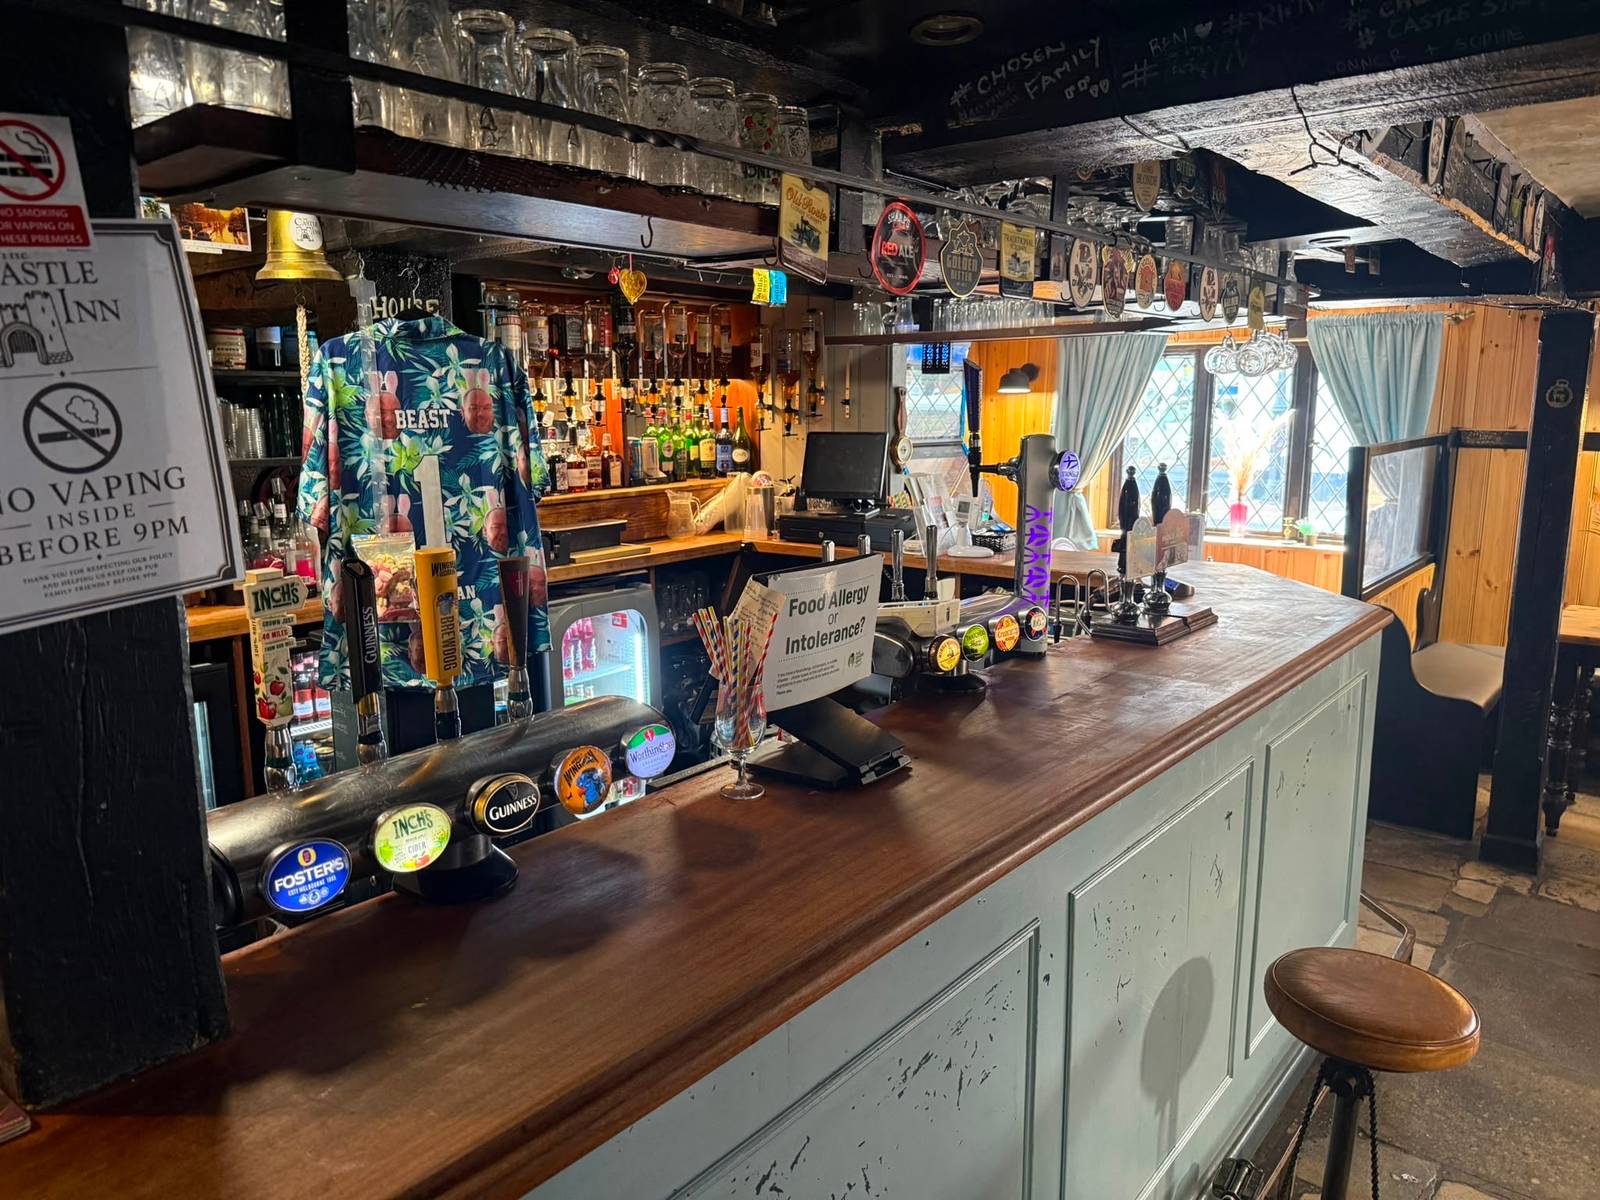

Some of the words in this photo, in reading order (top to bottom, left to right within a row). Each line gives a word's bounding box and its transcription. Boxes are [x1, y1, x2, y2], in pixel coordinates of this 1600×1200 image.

[1024, 36, 1102, 101] FAMILY
[14, 221, 56, 231] VAPING
[57, 222, 75, 231] ON
[16, 208, 68, 218] SMOKING
[0, 234, 30, 243] HESE
[31, 234, 83, 244] PREMISES
[898, 244, 914, 258] ALE
[0, 260, 99, 286] ASTLE
[56, 288, 121, 324] INN
[394, 408, 452, 430] BEAST
[48, 466, 186, 506] VAPING
[412, 453, 452, 549] 1
[47, 503, 136, 530] INSIDE
[0, 527, 121, 566] BEFORE
[133, 515, 190, 543] 9PM
[23, 574, 49, 585] THANK
[52, 571, 68, 580] YOU
[70, 568, 84, 576] FOR
[86, 560, 131, 573] RESPECTING
[132, 556, 147, 565] OUR
[150, 552, 174, 562] POLICY
[61, 575, 94, 587] HELPING
[127, 566, 143, 574] OUR
[44, 588, 73, 599] FAMILY
[75, 581, 111, 593] FRIENDLY
[113, 575, 140, 585] BEFORE
[251, 582, 300, 613] INCH'S
[457, 584, 476, 601] AN
[788, 593, 826, 618] Food
[828, 584, 870, 611] Allergy
[827, 611, 839, 625] or
[262, 632, 270, 641] 40
[364, 605, 377, 665] GUINNESS
[440, 615, 458, 672] BREWDOG
[785, 616, 866, 656] Intolerance?
[489, 793, 537, 821] GUINNESS
[391, 809, 433, 840] INCH'S
[408, 840, 427, 854] CIDER
[274, 856, 345, 893] FOSTER'S
